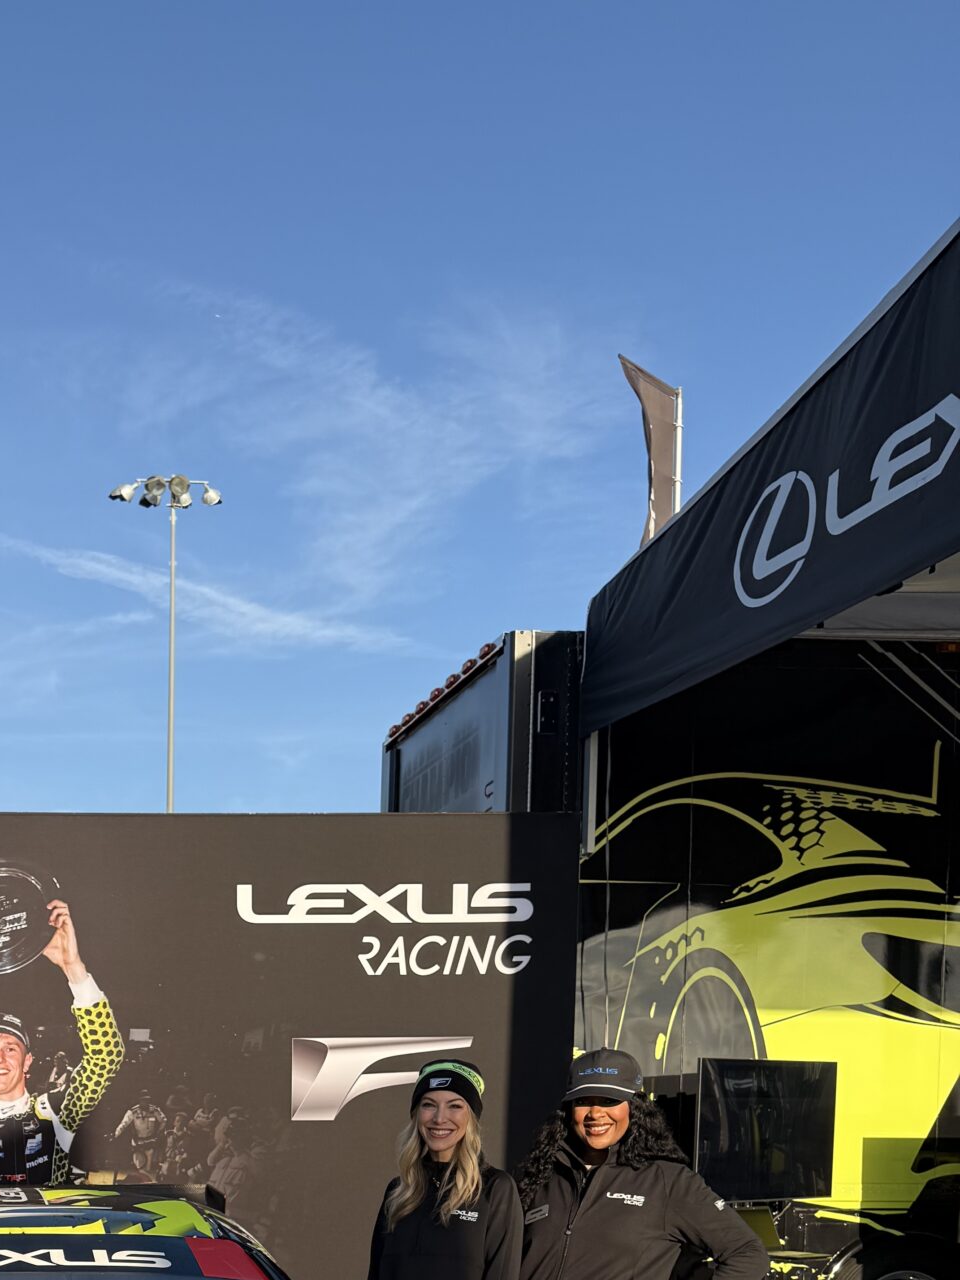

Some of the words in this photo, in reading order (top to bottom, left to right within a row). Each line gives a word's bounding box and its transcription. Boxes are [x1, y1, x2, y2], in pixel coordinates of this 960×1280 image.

[236, 882, 535, 924] LEXUS
[357, 934, 533, 976] RACING
[579, 1067, 619, 1076] LEXUS
